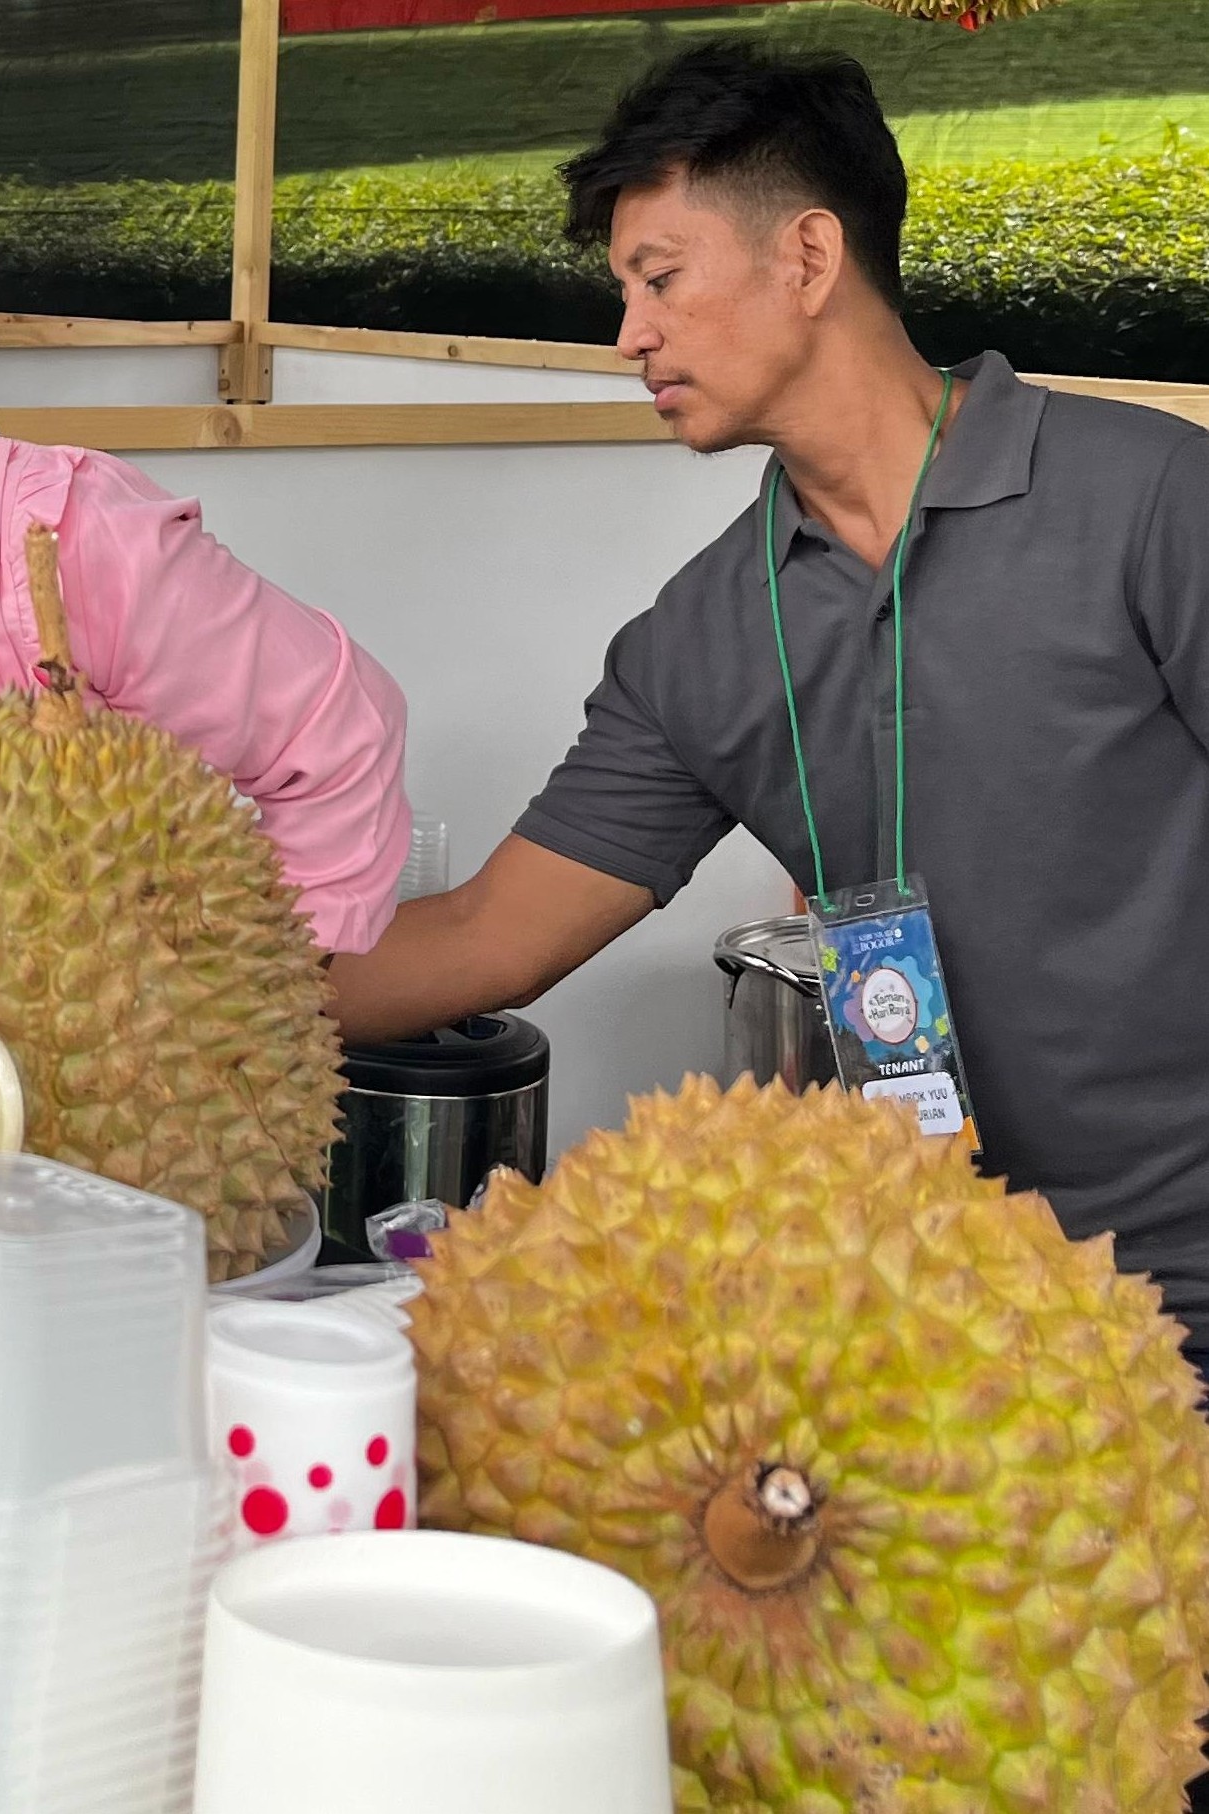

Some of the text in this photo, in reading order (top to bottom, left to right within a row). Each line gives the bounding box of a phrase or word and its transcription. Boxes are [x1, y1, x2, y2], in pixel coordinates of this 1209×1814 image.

[872, 993, 905, 1007] Taman
[878, 1058, 925, 1076] TENANT
[927, 1087, 948, 1101] YUU
[919, 1107, 946, 1122] URIAN
